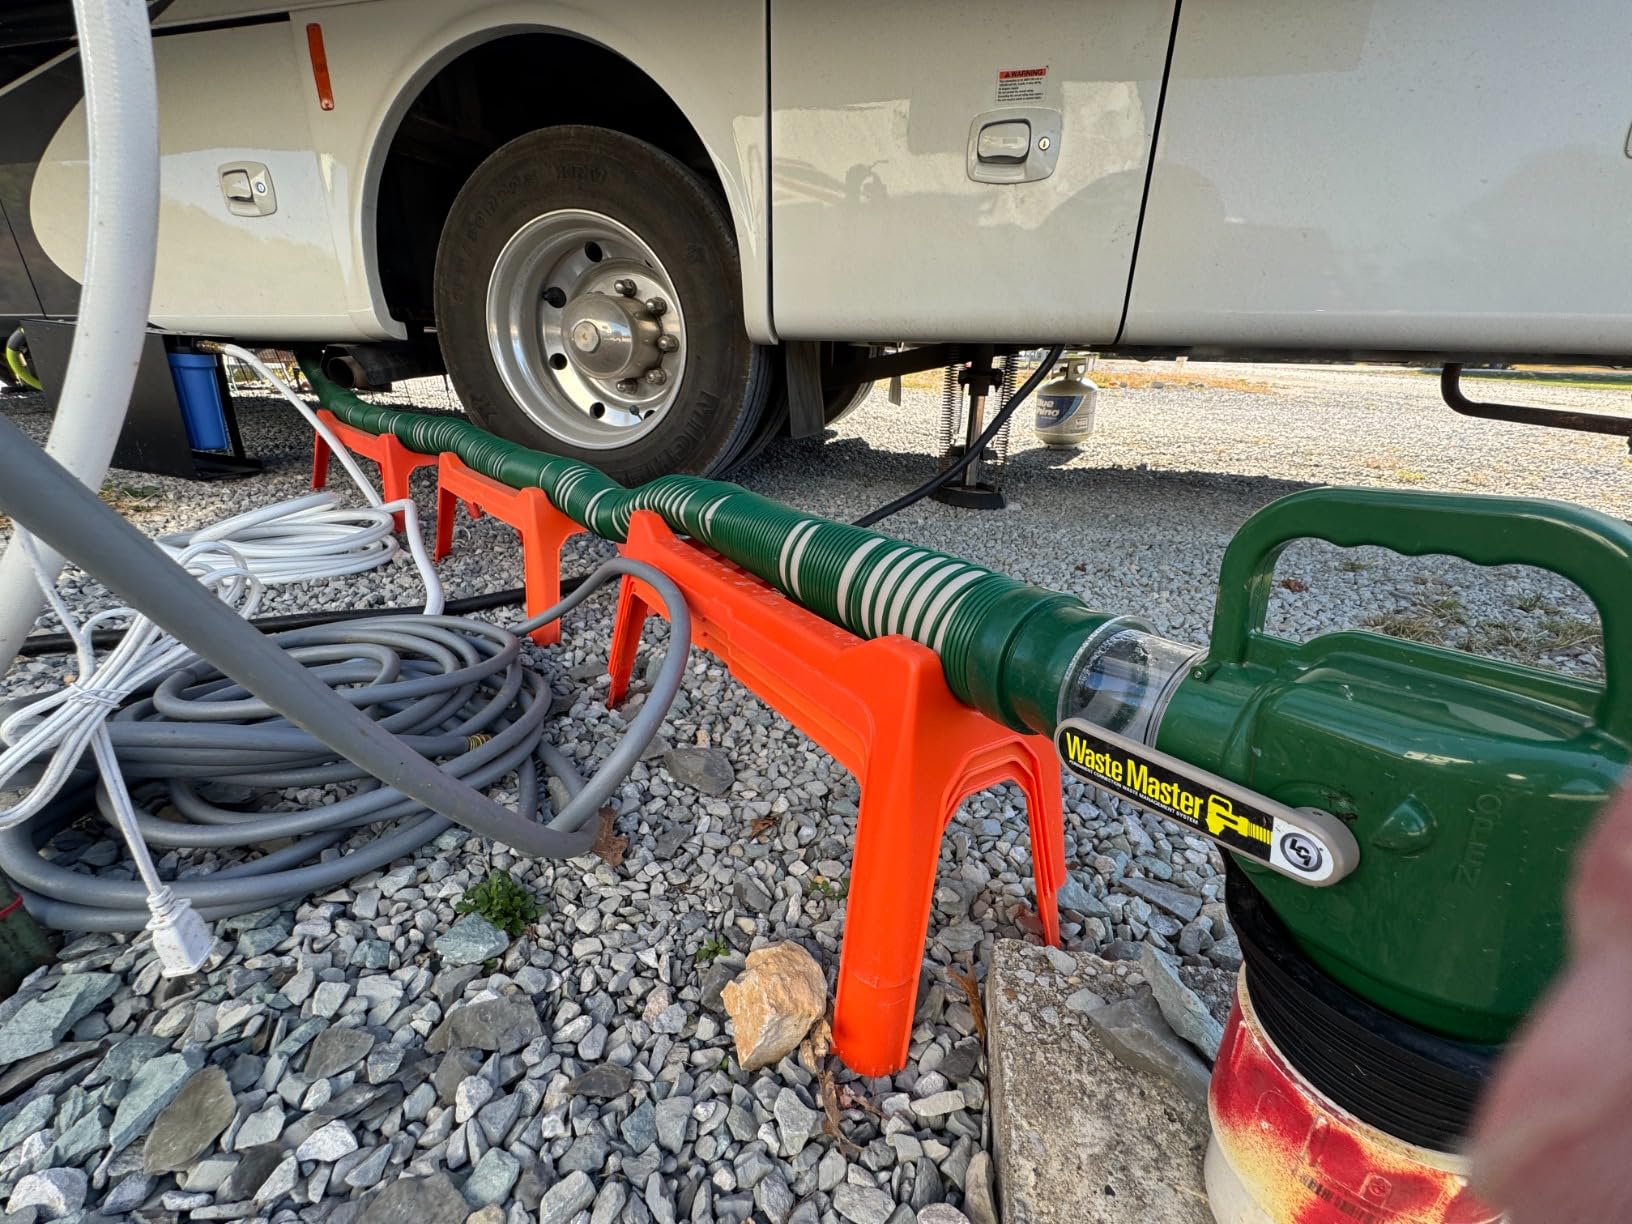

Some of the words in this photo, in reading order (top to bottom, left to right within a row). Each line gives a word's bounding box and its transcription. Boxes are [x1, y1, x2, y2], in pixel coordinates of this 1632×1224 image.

[1010, 69, 1044, 78] WARNING
[1066, 732, 1123, 782] Waste
[1126, 758, 1204, 820] Master
[1093, 771, 1122, 788] CONNECTION
[1122, 785, 1139, 796] WASTE
[1139, 793, 1175, 814] MANAGEMENT
[1176, 811, 1199, 825] SYSTEM
